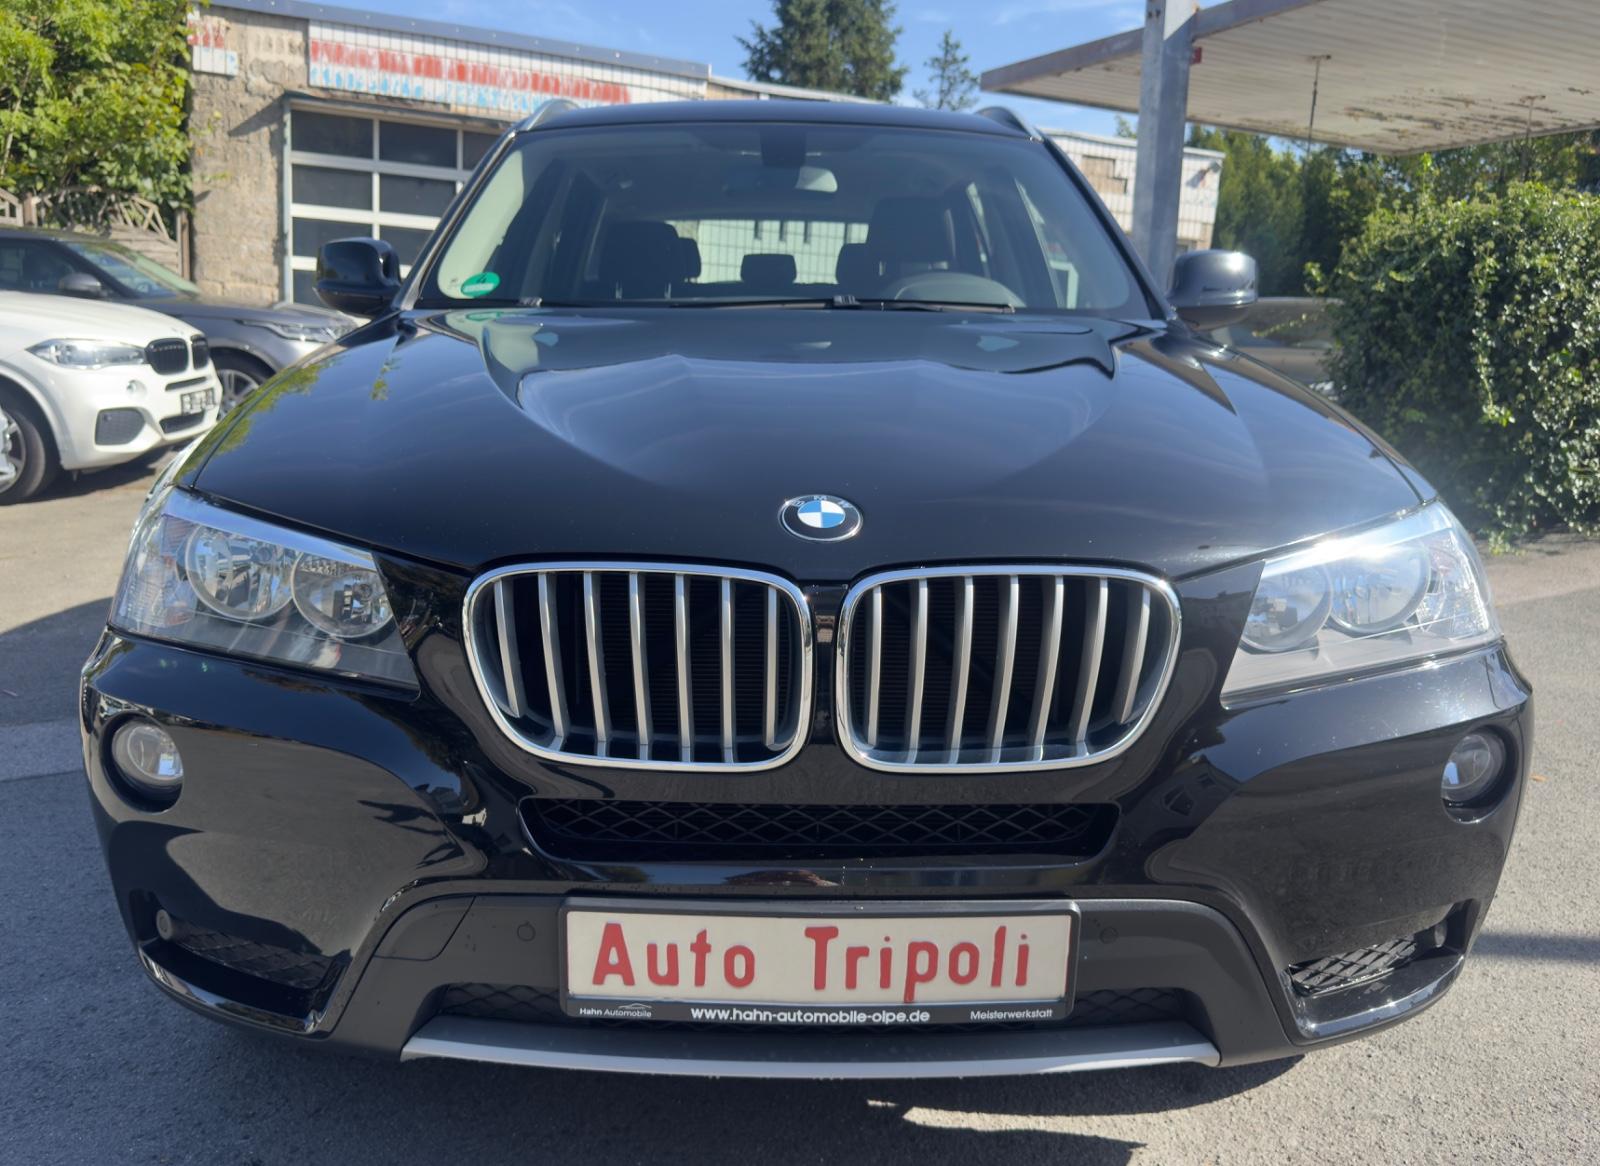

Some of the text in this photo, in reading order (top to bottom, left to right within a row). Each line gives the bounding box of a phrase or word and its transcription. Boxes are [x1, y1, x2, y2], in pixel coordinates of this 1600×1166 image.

[592, 921, 1030, 1004] Auto Tripoli
[579, 1007, 652, 1018] Hahn Automobile
[691, 1006, 931, 1025] www.hahn-automobile-olpe.de
[970, 1008, 1054, 1020] Meisterwerkstatt
